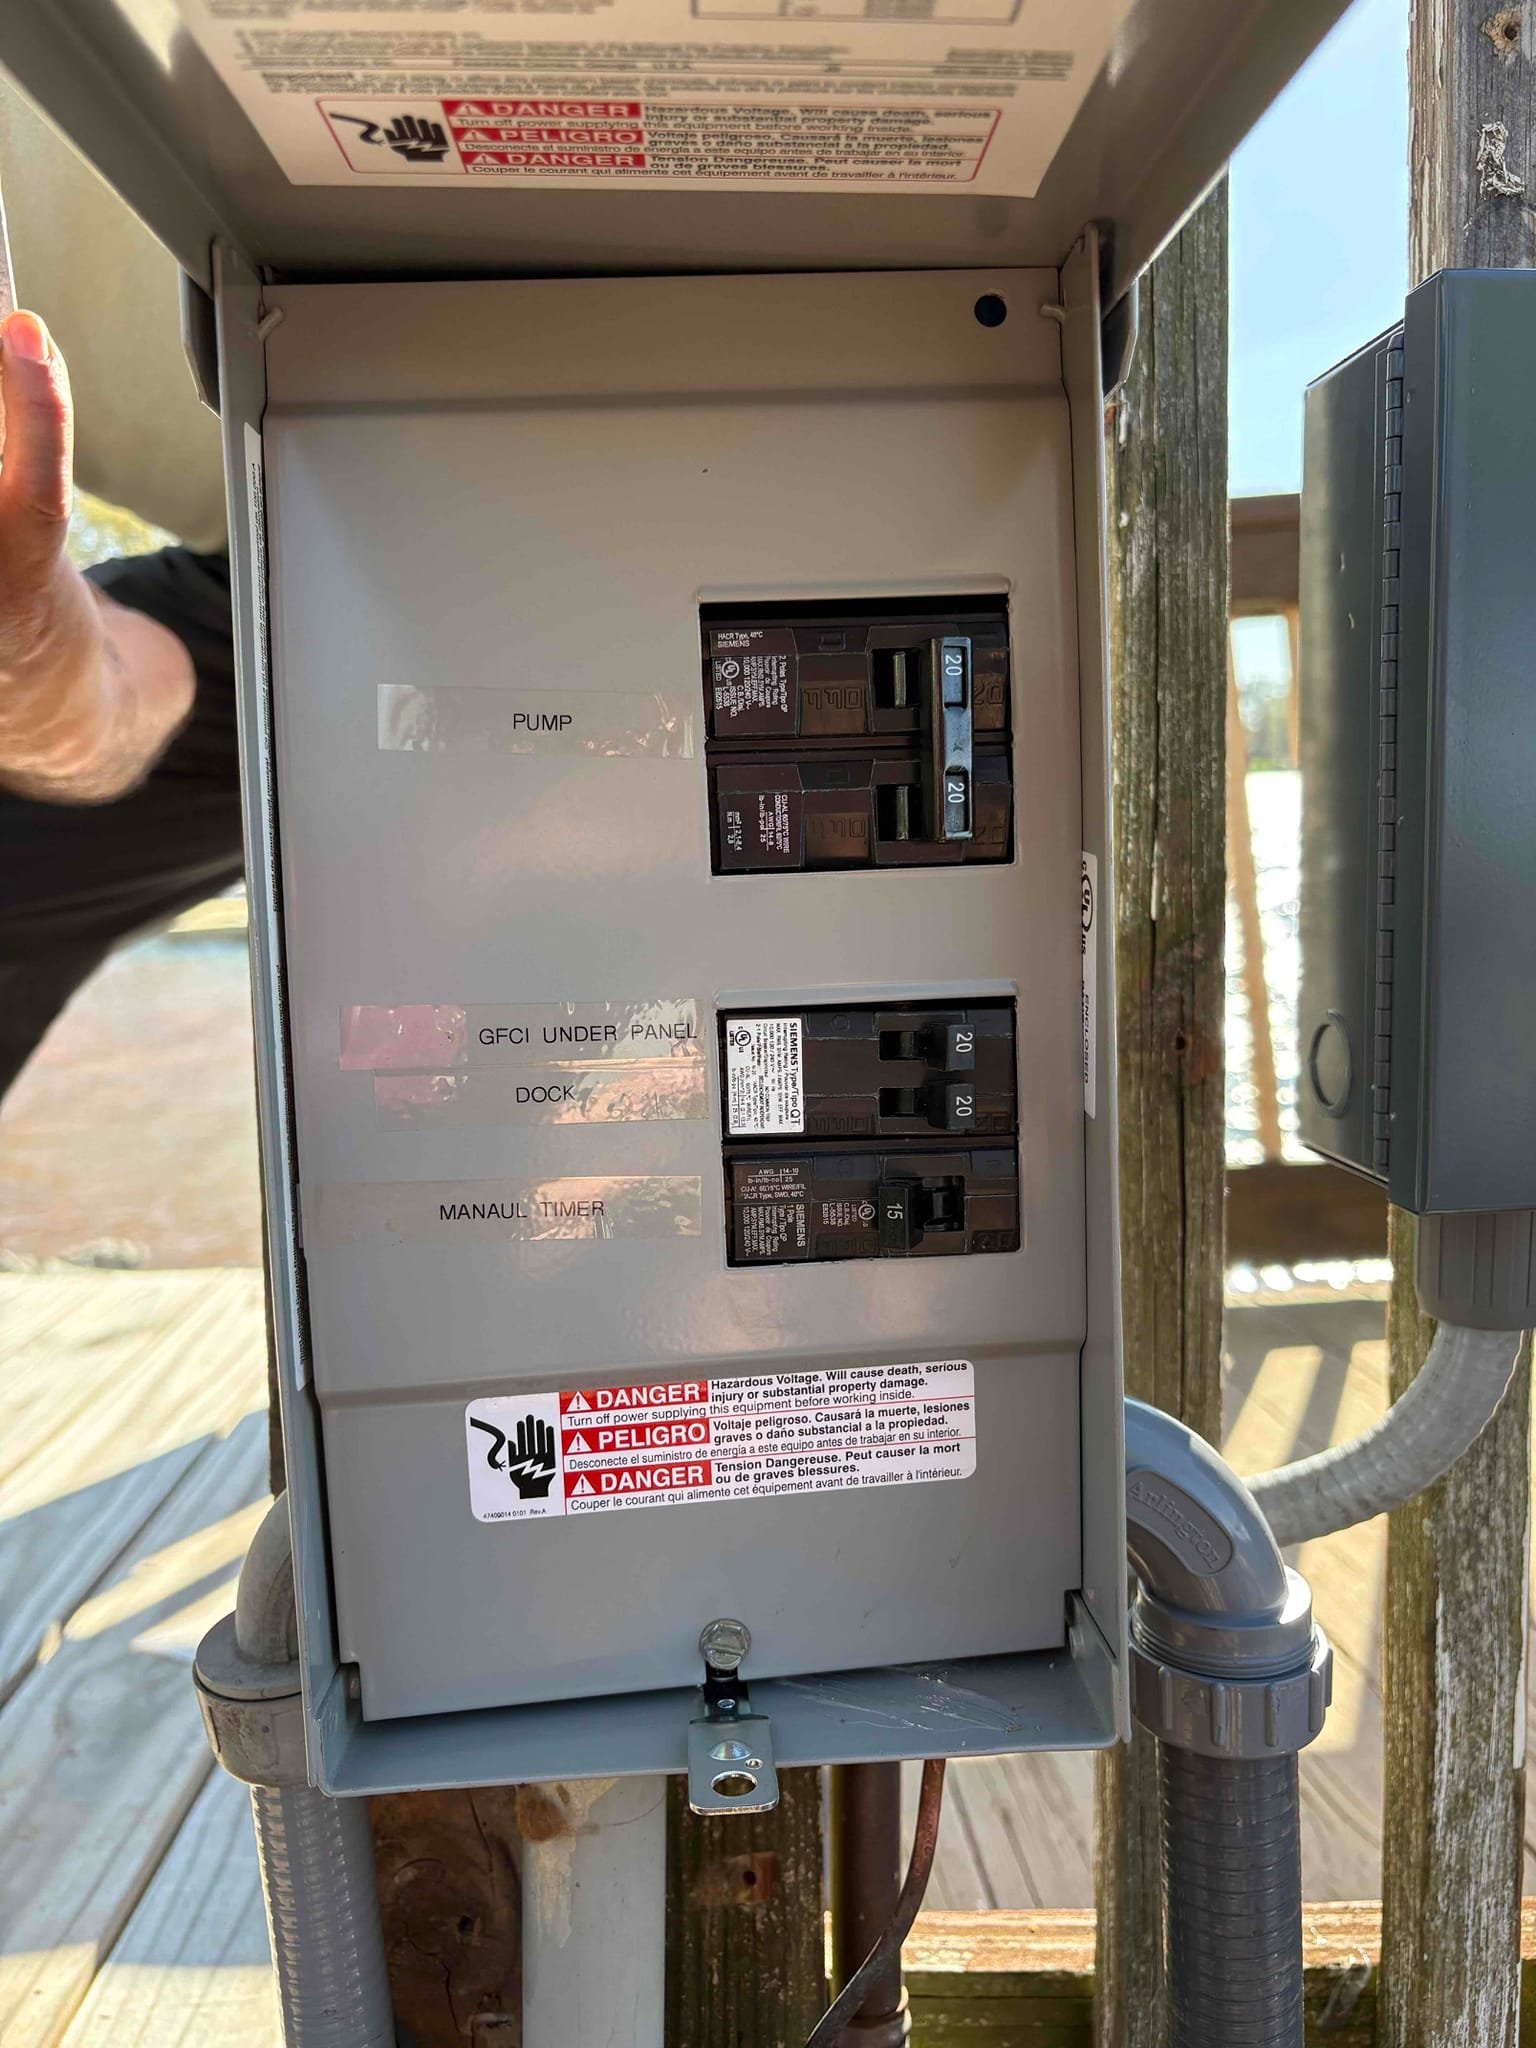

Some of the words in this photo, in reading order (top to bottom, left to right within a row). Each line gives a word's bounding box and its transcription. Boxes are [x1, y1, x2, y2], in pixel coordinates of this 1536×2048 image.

[492, 104, 629, 117] DANGER
[501, 130, 638, 143] PELIGRO
[507, 155, 634, 166] DANGER
[718, 640, 750, 648] SIEMENS
[945, 655, 962, 676] 20
[512, 712, 573, 732] PUMP
[948, 782, 965, 804] 20
[478, 1026, 530, 1046] GFCI
[543, 1024, 617, 1044] UNDER
[630, 1022, 697, 1041] PANEL
[790, 1022, 799, 1066] SIEMENS
[956, 1032, 973, 1053] 20
[516, 1085, 575, 1104] DOCK
[790, 1067, 799, 1107] Type/Tipo
[791, 1109, 801, 1125] QT
[956, 1095, 973, 1117] 20
[439, 1202, 527, 1221] MANAUL
[540, 1200, 604, 1218] TIMER
[886, 1203, 904, 1220] 15
[796, 1204, 805, 1247] SIEMENS
[711, 1378, 773, 1390] Hazardous
[776, 1374, 822, 1385] Voltage.
[826, 1371, 846, 1381] Will
[849, 1370, 884, 1379] cause
[886, 1365, 921, 1376] death,
[925, 1363, 967, 1373] serious
[596, 1383, 700, 1408] DANGER
[711, 1392, 743, 1404] injury
[747, 1391, 759, 1399] or
[762, 1384, 824, 1398] substantial
[828, 1381, 876, 1395] property
[879, 1378, 927, 1389] damage.
[568, 1416, 592, 1427] Turn
[595, 1413, 610, 1425] off
[613, 1412, 648, 1426] power
[651, 1407, 706, 1421] supplying
[709, 1404, 729, 1415] this
[732, 1399, 791, 1415] equipment
[794, 1397, 830, 1408] before
[832, 1393, 876, 1405] working
[879, 1390, 914, 1401] inside.
[713, 1419, 751, 1431] Voltaje
[754, 1416, 811, 1430] peligroso.
[814, 1409, 861, 1423] Causará
[864, 1409, 875, 1419] la
[877, 1405, 920, 1418] muerte,
[923, 1403, 970, 1414] lesiones
[598, 1423, 705, 1450] PELIGRO
[713, 1432, 752, 1444] graves
[755, 1431, 763, 1439] o
[766, 1427, 794, 1438] daño
[797, 1422, 862, 1436] substancial
[865, 1423, 872, 1431] a
[875, 1420, 885, 1430] la
[888, 1415, 948, 1431] propiedad.
[569, 1456, 627, 1470] Desconecte
[630, 1454, 639, 1465] el
[641, 1450, 692, 1464] suministro
[694, 1449, 707, 1459] de
[710, 1445, 746, 1458] energía
[749, 1446, 755, 1454] a
[757, 1443, 778, 1453] este
[780, 1440, 814, 1453] equipo
[816, 1438, 842, 1448] antes
[845, 1436, 857, 1446] de
[859, 1433, 896, 1444] trabajar
[898, 1433, 910, 1441] en
[913, 1431, 924, 1440] su
[927, 1427, 960, 1438] interior.
[715, 1460, 762, 1472] Tension
[765, 1455, 841, 1468] Dangereuse.
[845, 1450, 872, 1461] Peut
[875, 1448, 915, 1459] causer
[919, 1446, 929, 1455] la
[933, 1443, 960, 1454] mort
[600, 1465, 704, 1492] DANGER
[715, 1475, 730, 1484] ou
[734, 1472, 749, 1482] de
[753, 1470, 793, 1483] graves
[798, 1465, 859, 1477] blessures.
[570, 1499, 610, 1511] Couper
[613, 1496, 622, 1507] le
[625, 1492, 664, 1506] courant
[667, 1491, 683, 1504] qui
[686, 1487, 730, 1500] alimente
[733, 1485, 749, 1496] cet
[752, 1479, 812, 1496] équipement
[815, 1477, 843, 1489] avant
[845, 1476, 858, 1486] de
[861, 1472, 903, 1485] travailler
[906, 1470, 913, 1481] à
[915, 1468, 961, 1480] l'intérieur.
[1128, 1481, 1219, 1568] Arlington
